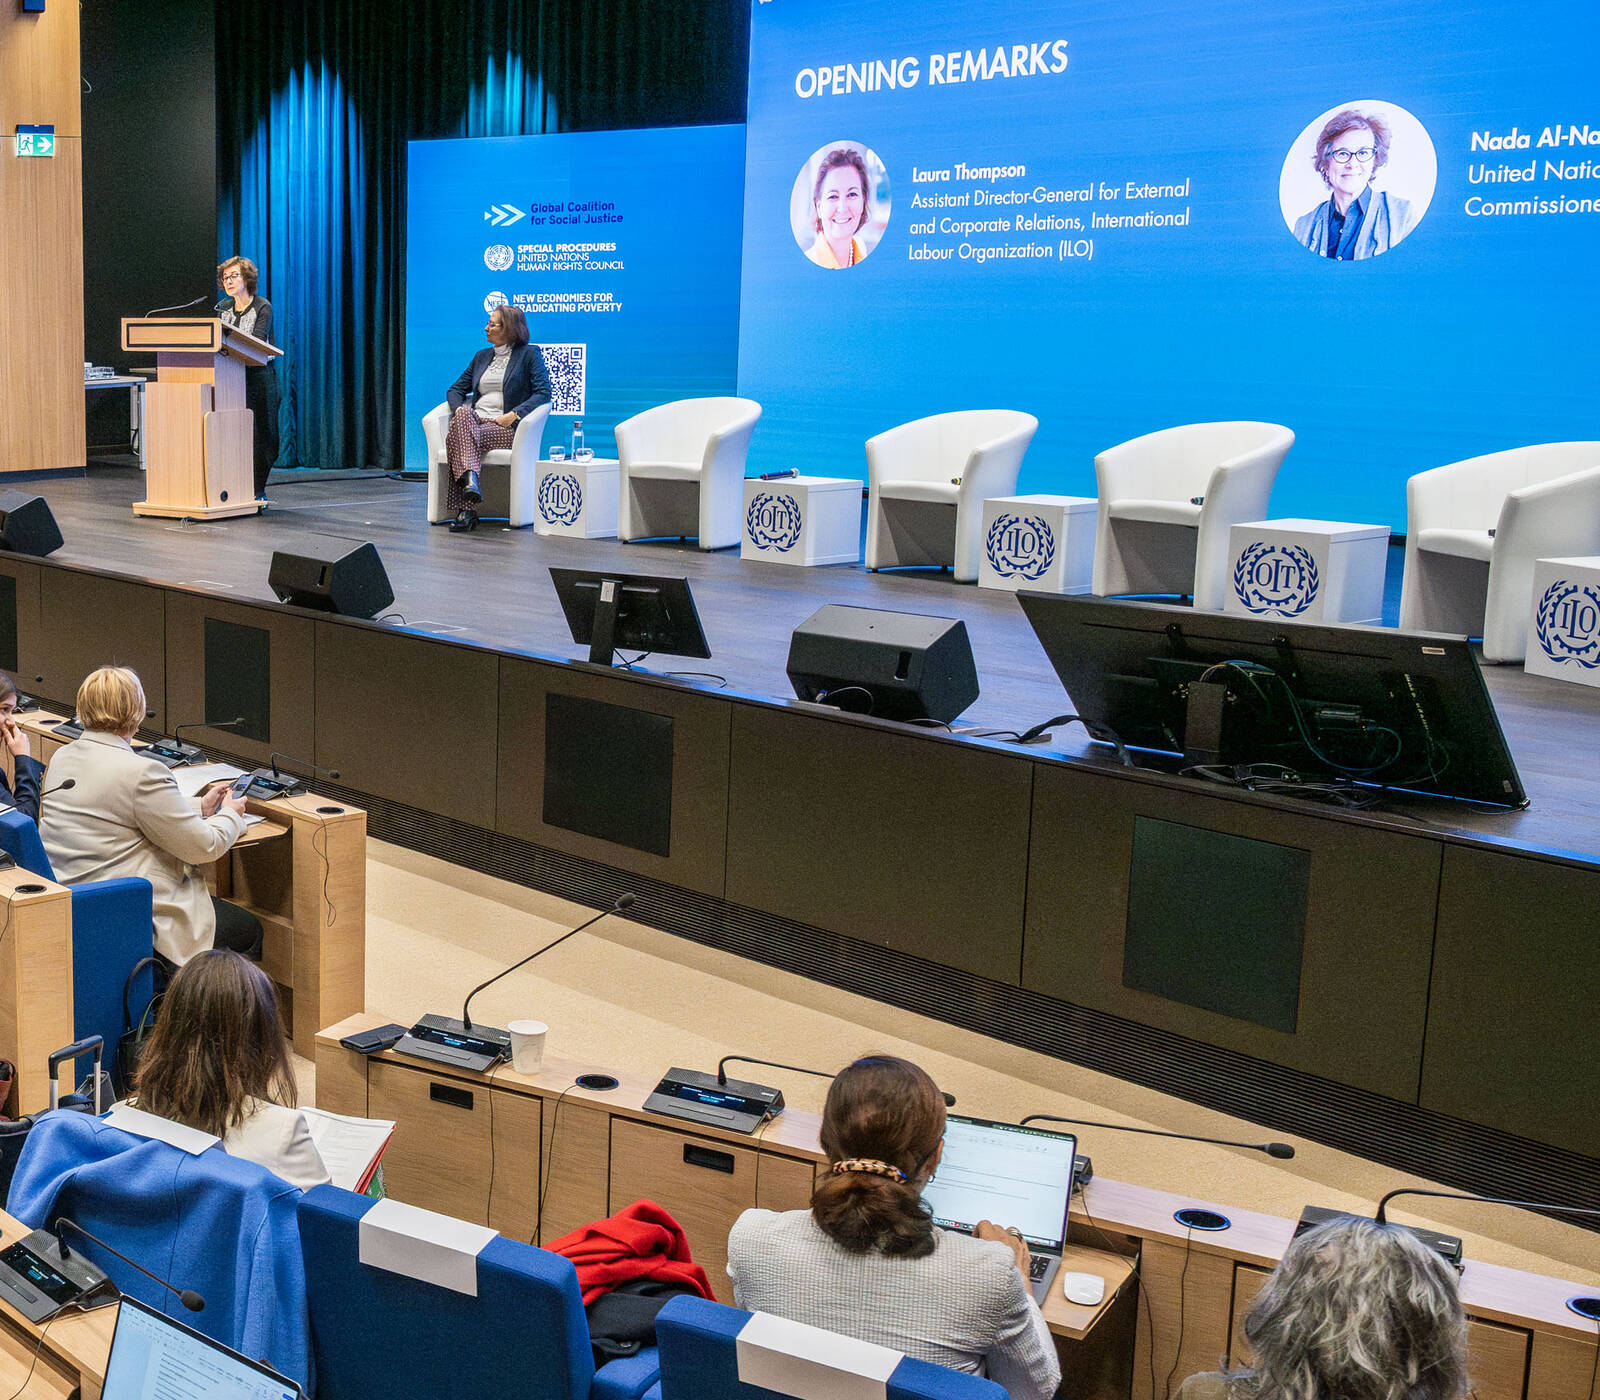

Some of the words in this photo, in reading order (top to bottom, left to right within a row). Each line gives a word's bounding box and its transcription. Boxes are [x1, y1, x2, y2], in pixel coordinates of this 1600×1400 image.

[795, 56, 920, 99] OPENING
[928, 39, 1069, 86] REMARKS
[1470, 127, 1531, 151] Nada
[912, 167, 950, 183] Laura
[954, 162, 1026, 184] Thompson
[1468, 160, 1537, 184] United
[911, 192, 970, 209] Assistant
[974, 182, 1094, 206] Director-General
[1099, 181, 1121, 201] for
[1125, 177, 1190, 200] External
[531, 203, 564, 214] Global
[568, 201, 615, 212] Coalition
[531, 215, 546, 226] for
[549, 214, 581, 225] Social
[584, 212, 624, 224] Justice
[909, 216, 936, 234] and
[940, 217, 1011, 238] Corporate
[1015, 212, 1085, 233] Relations,
[1091, 206, 1190, 229] International
[517, 244, 554, 254] SPECIAL
[556, 242, 617, 253] PROCEDURES
[517, 253, 549, 263] UNITED
[550, 252, 590, 262] NATIONS
[908, 243, 954, 260] Labour
[958, 242, 1053, 264] Organization
[1059, 239, 1094, 261] (ILO)
[517, 263, 551, 272] HUMAN
[553, 261, 583, 271] RIGHTS
[585, 260, 625, 270] COUNCIL
[513, 294, 536, 303] NEW
[537, 293, 593, 303] ECONOMIES
[594, 292, 614, 302] FOR
[578, 302, 623, 313] POVERTY
[551, 484, 570, 509] ILO
[761, 505, 787, 533] OIT
[1006, 527, 1036, 559] ILO
[1255, 558, 1296, 593] OIT
[1559, 599, 1597, 640] ILO
